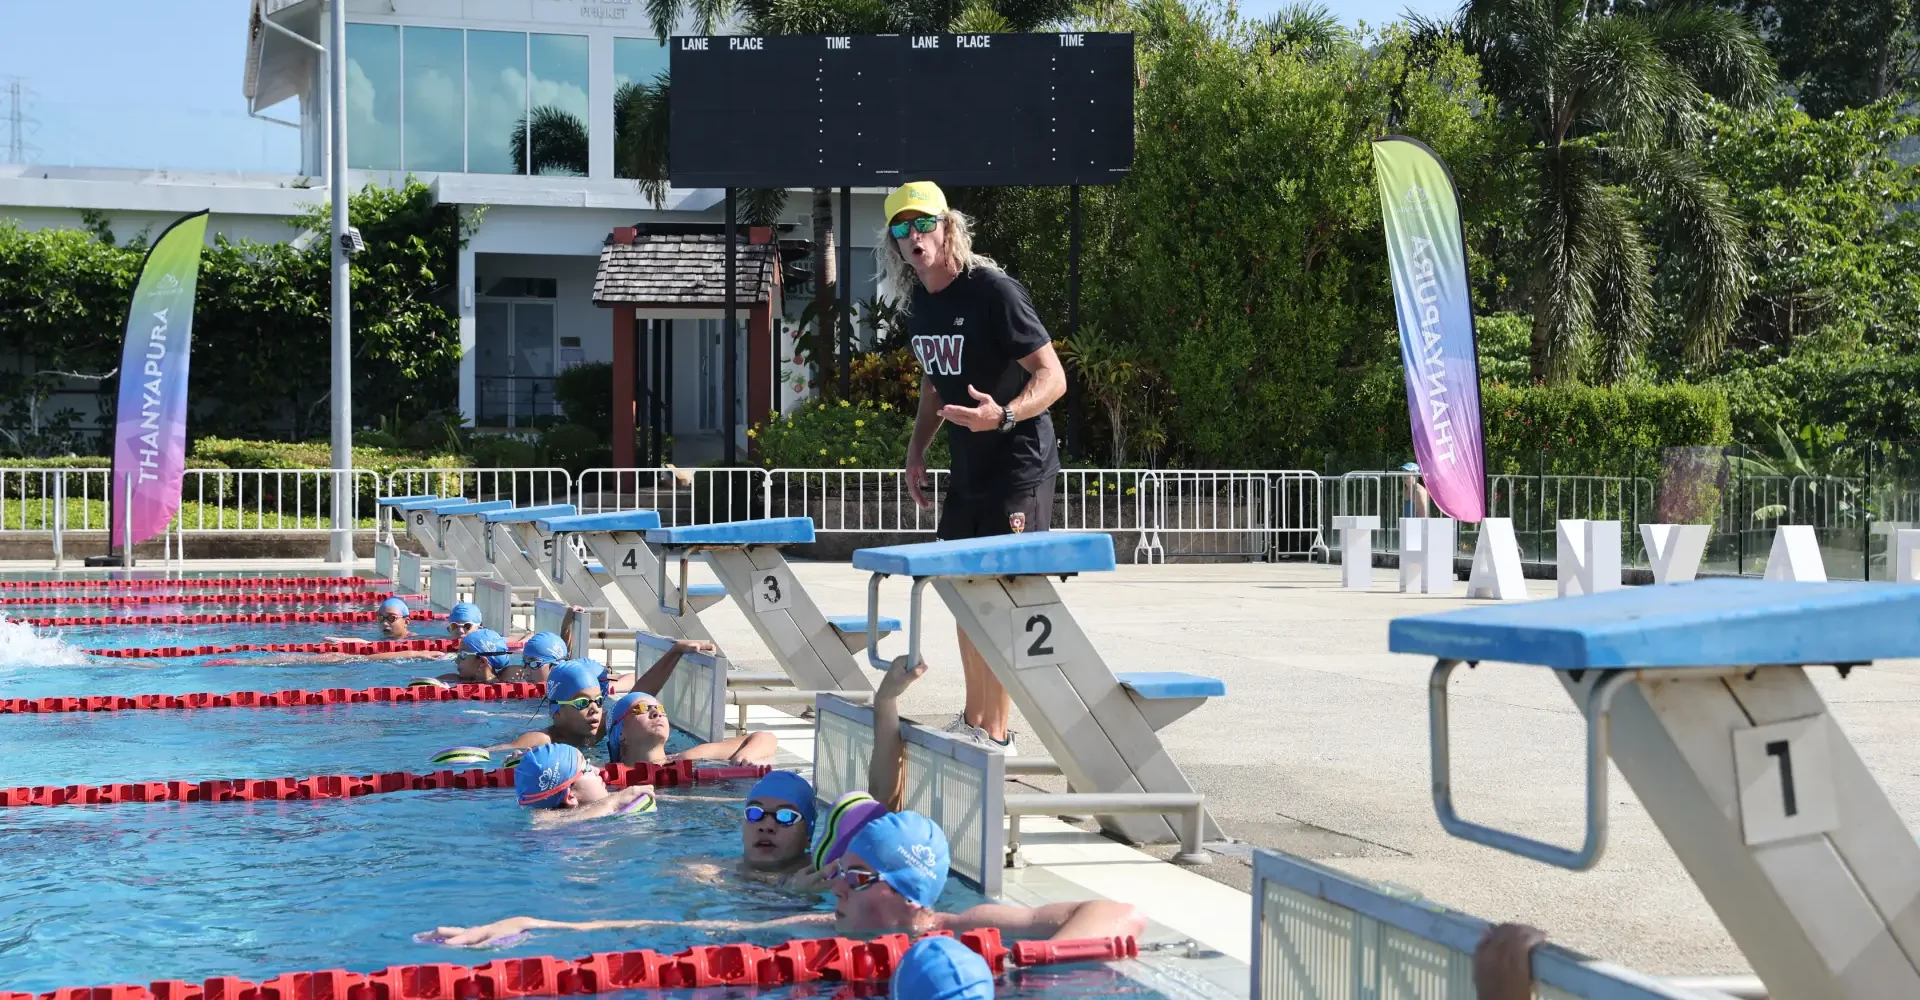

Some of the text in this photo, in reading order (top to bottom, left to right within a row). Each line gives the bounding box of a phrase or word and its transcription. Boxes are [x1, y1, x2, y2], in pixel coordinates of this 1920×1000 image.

[580, 7, 628, 19] PHUKET
[682, 34, 1084, 50] LANE PLACE TIME LANE PLACE TIME
[138, 307, 169, 484] THANYAPURA
[416, 514, 424, 525] 8
[622, 548, 638, 570] 4
[763, 575, 781, 604] 3
[1025, 613, 1054, 657] 2
[1765, 739, 1798, 818] 1
